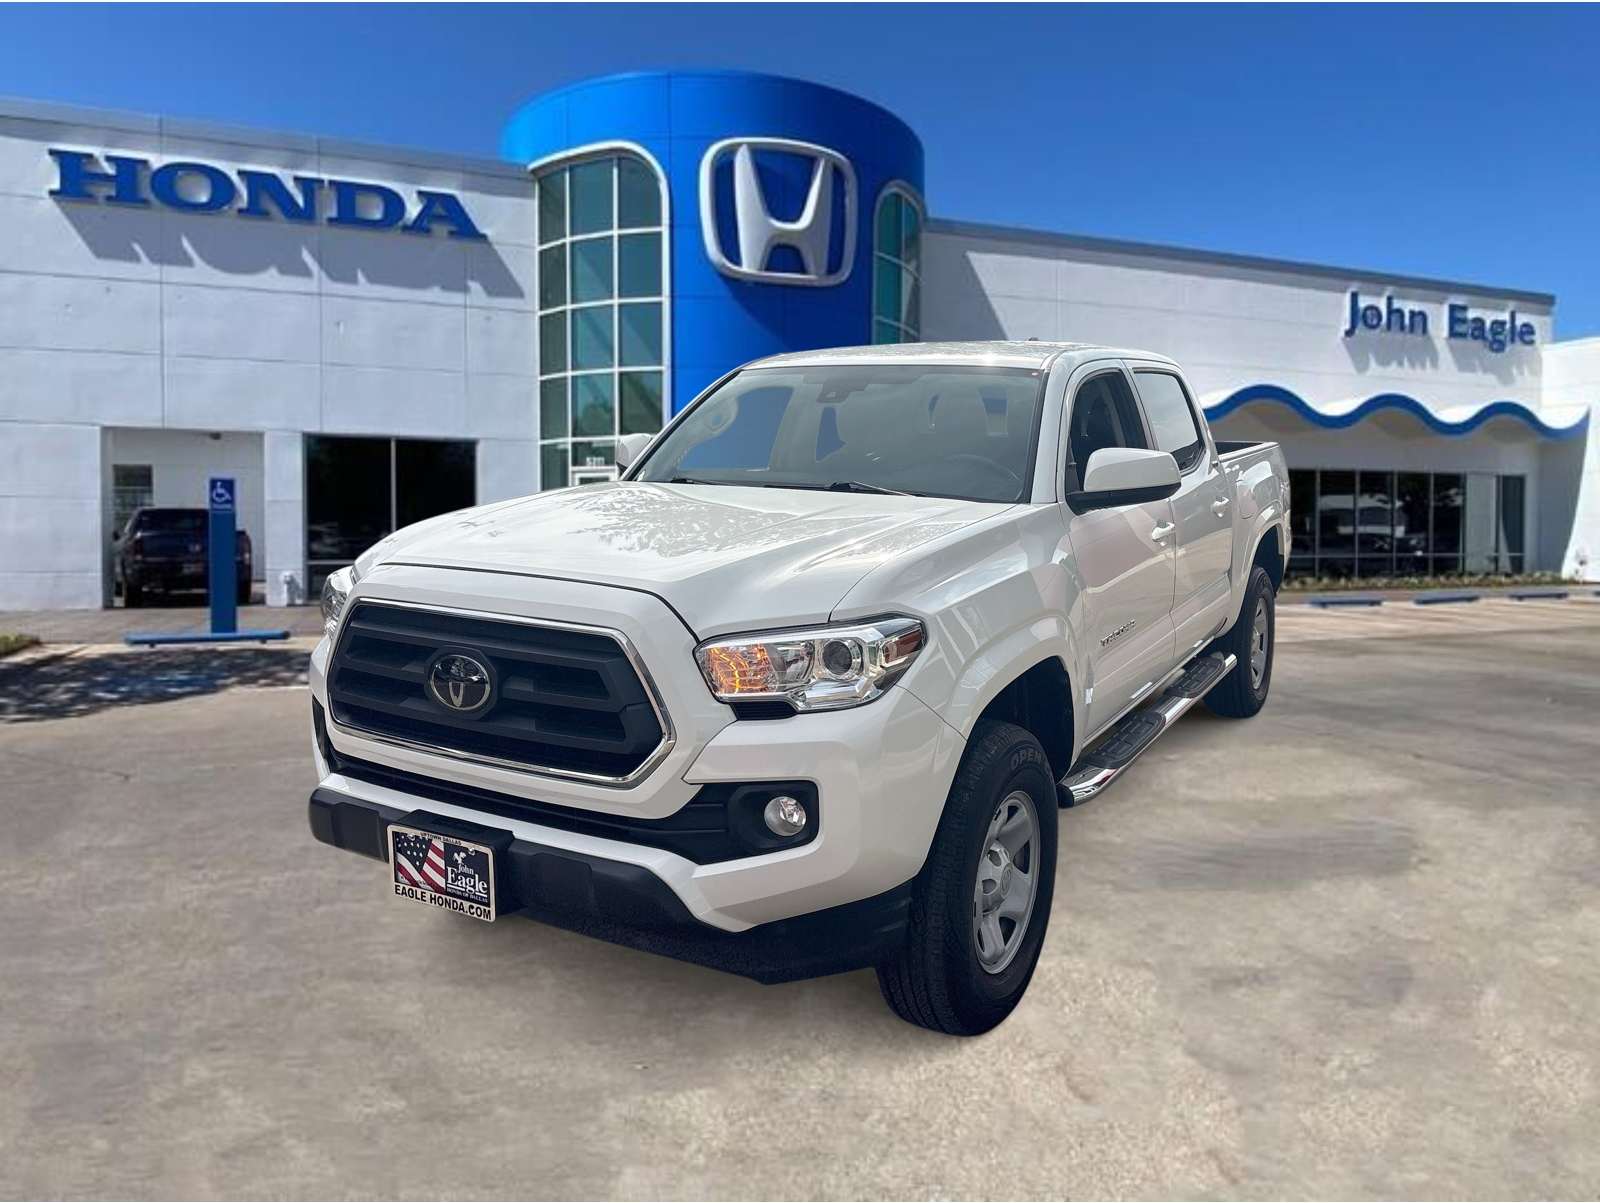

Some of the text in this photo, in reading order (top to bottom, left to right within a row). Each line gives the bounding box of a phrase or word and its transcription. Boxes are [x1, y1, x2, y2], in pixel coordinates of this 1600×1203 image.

[48, 148, 488, 241] HONDA
[1344, 291, 1536, 354] John Eagle
[446, 866, 488, 895] Eagle
[457, 863, 475, 875] John
[394, 884, 491, 921] EAGLE HONDA.COM
